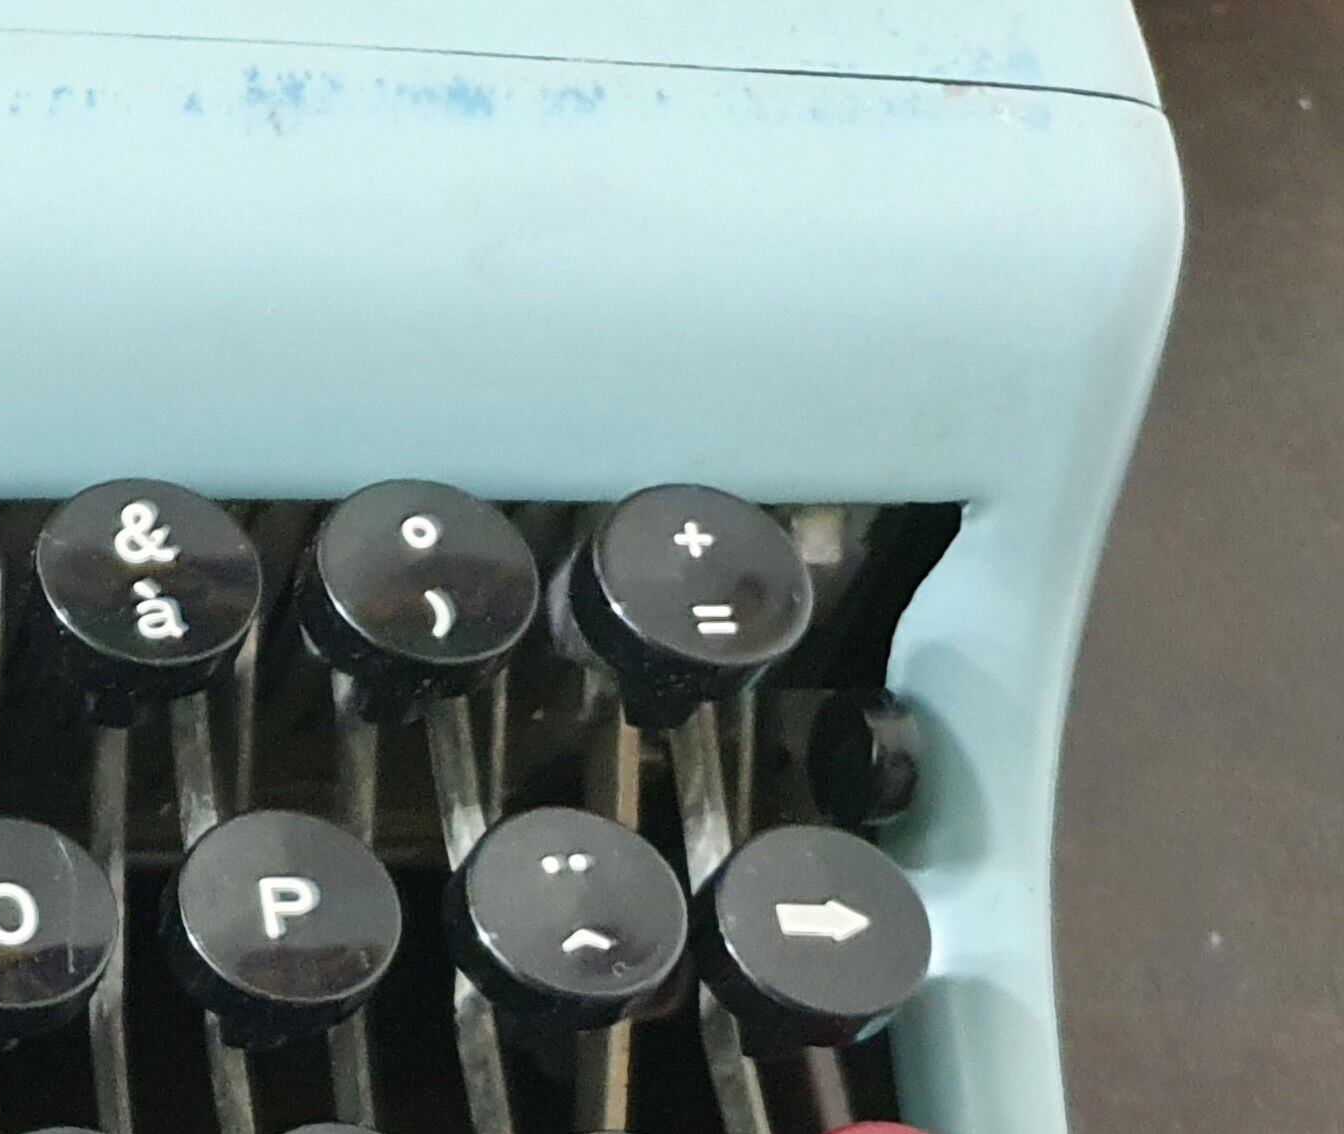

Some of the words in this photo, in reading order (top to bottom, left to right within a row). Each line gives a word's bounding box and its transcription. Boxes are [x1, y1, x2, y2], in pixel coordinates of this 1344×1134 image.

[113, 501, 178, 565] &
[673, 521, 714, 558] +
[132, 580, 188, 640] à
[424, 589, 452, 638] )
[692, 605, 738, 635] =
[258, 877, 319, 939] P
